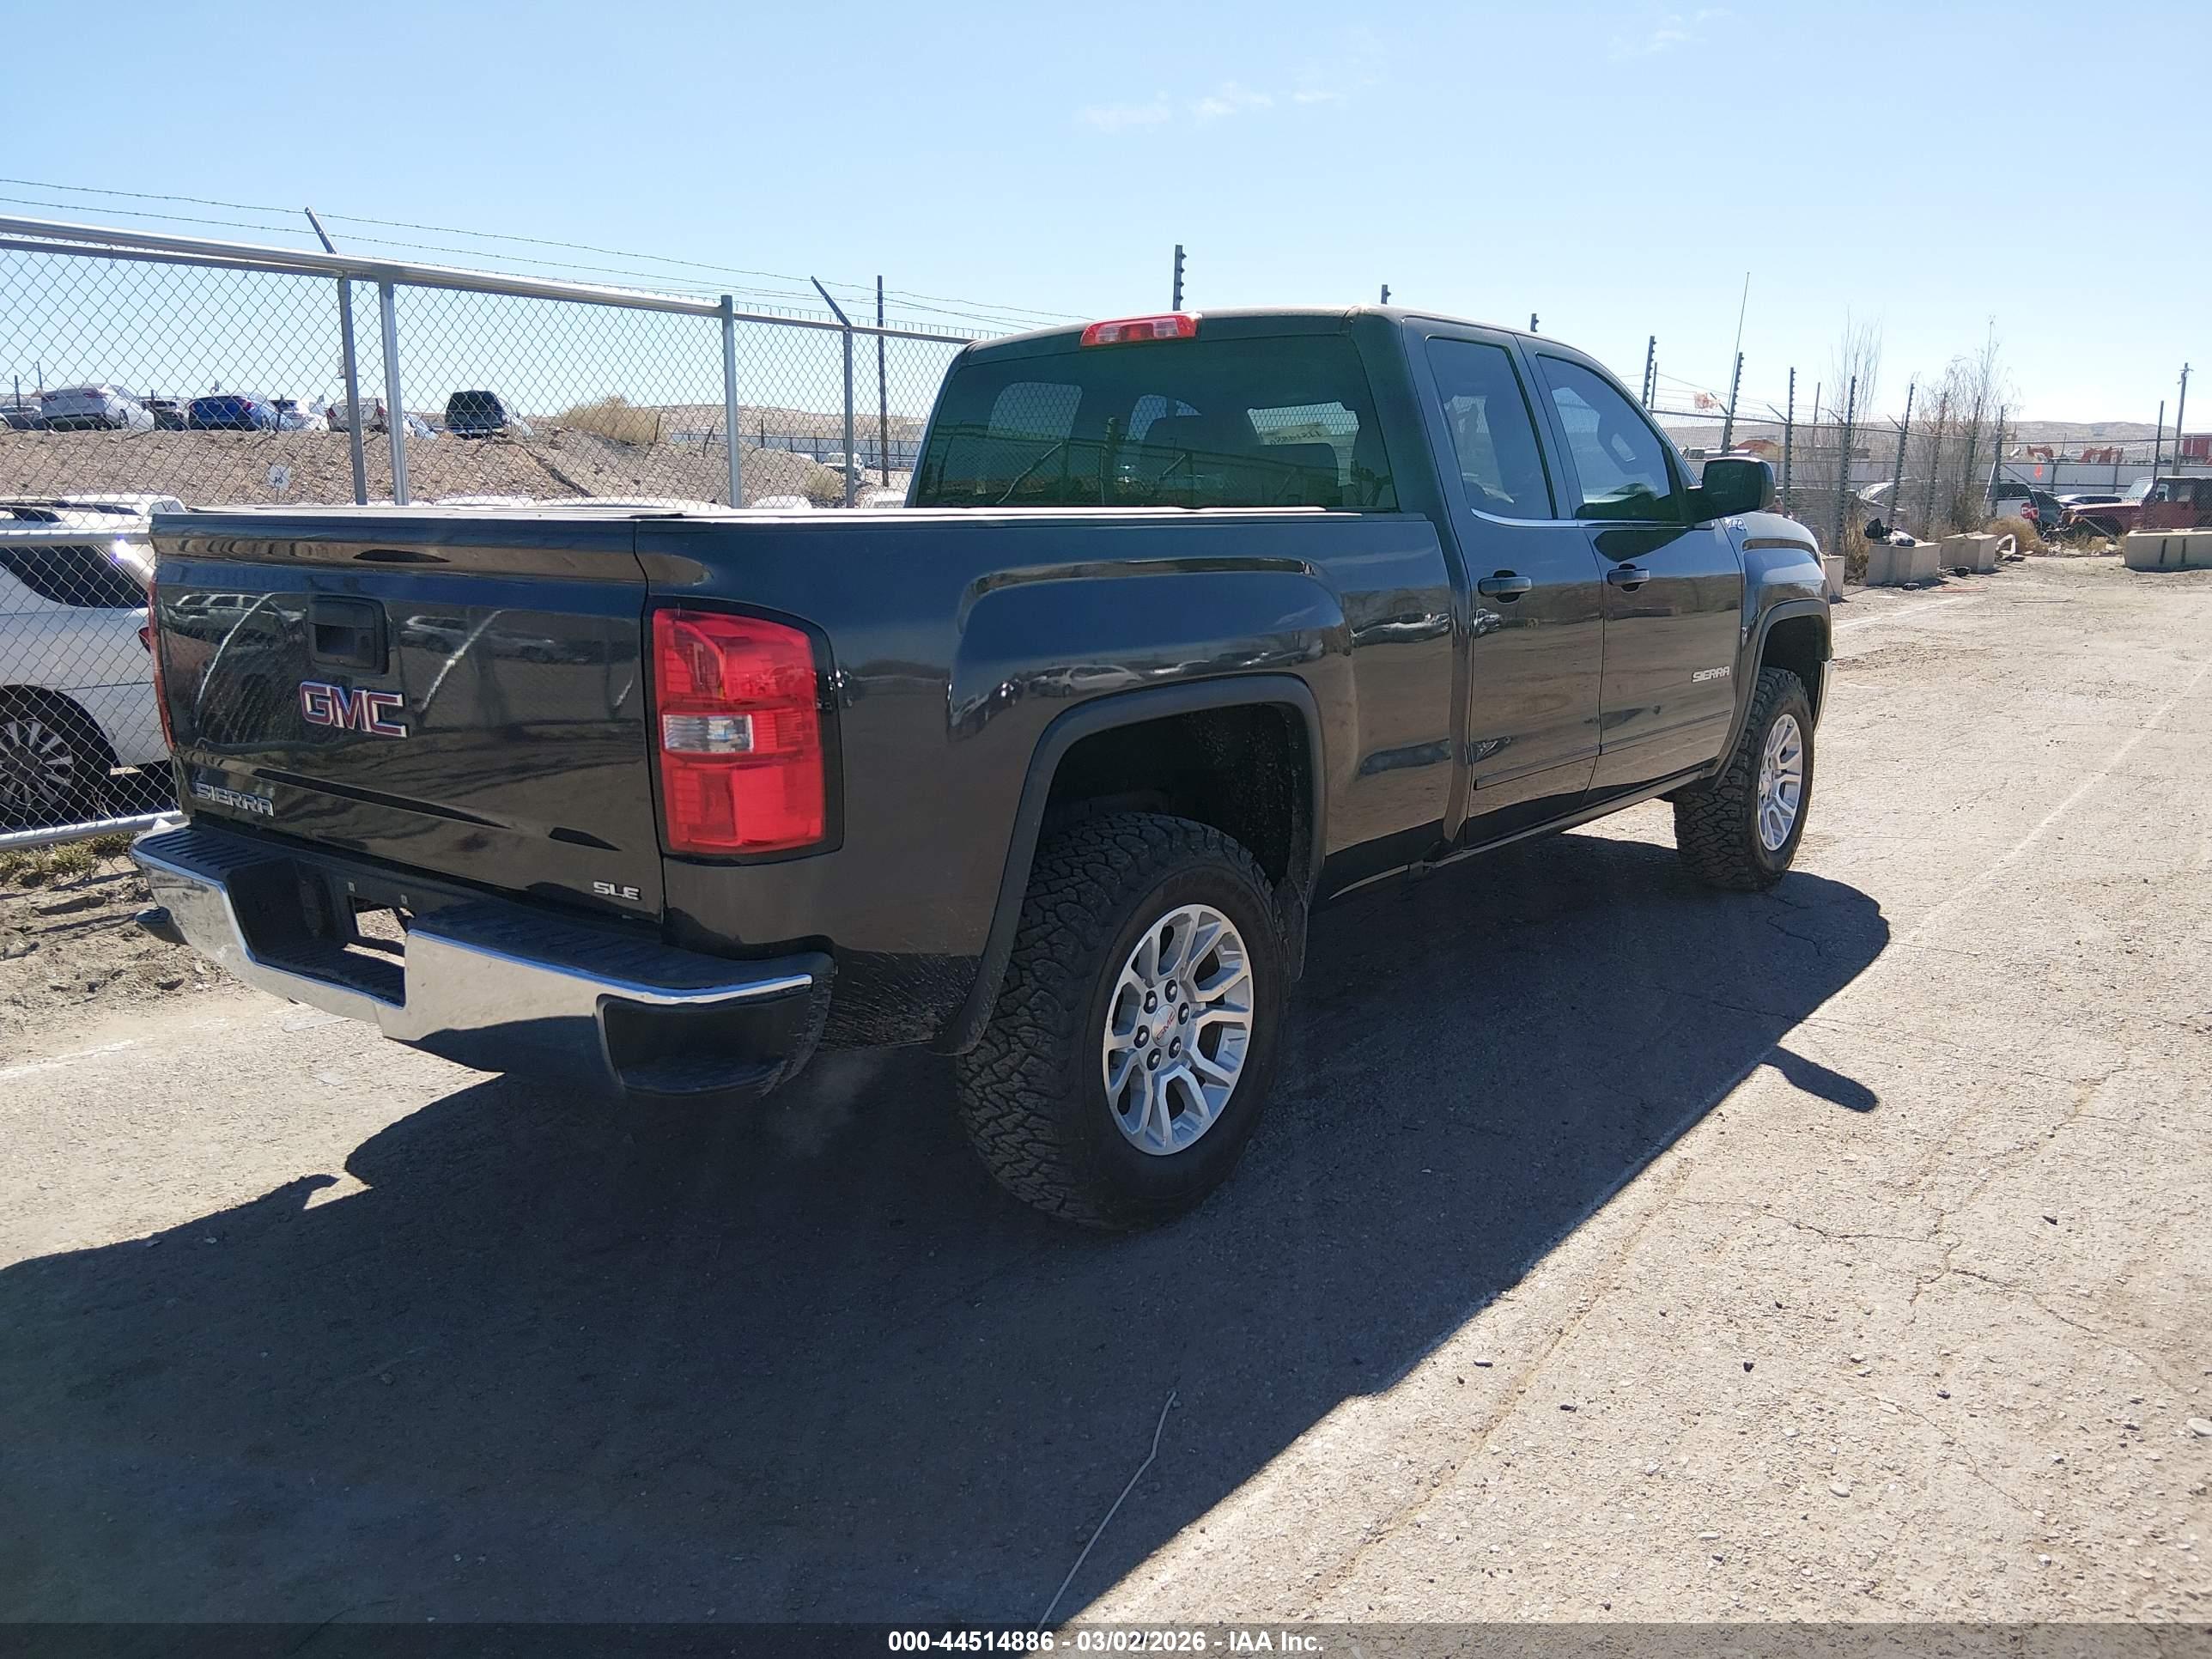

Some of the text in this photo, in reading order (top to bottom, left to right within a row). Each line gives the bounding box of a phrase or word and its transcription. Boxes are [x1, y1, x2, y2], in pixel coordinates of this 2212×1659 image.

[1692, 665, 1730, 683] SIERRA
[300, 680, 407, 738] GMC
[196, 782, 275, 817] SIERRA
[593, 881, 640, 901] SLE
[1156, 1011, 1176, 1040] GMC
